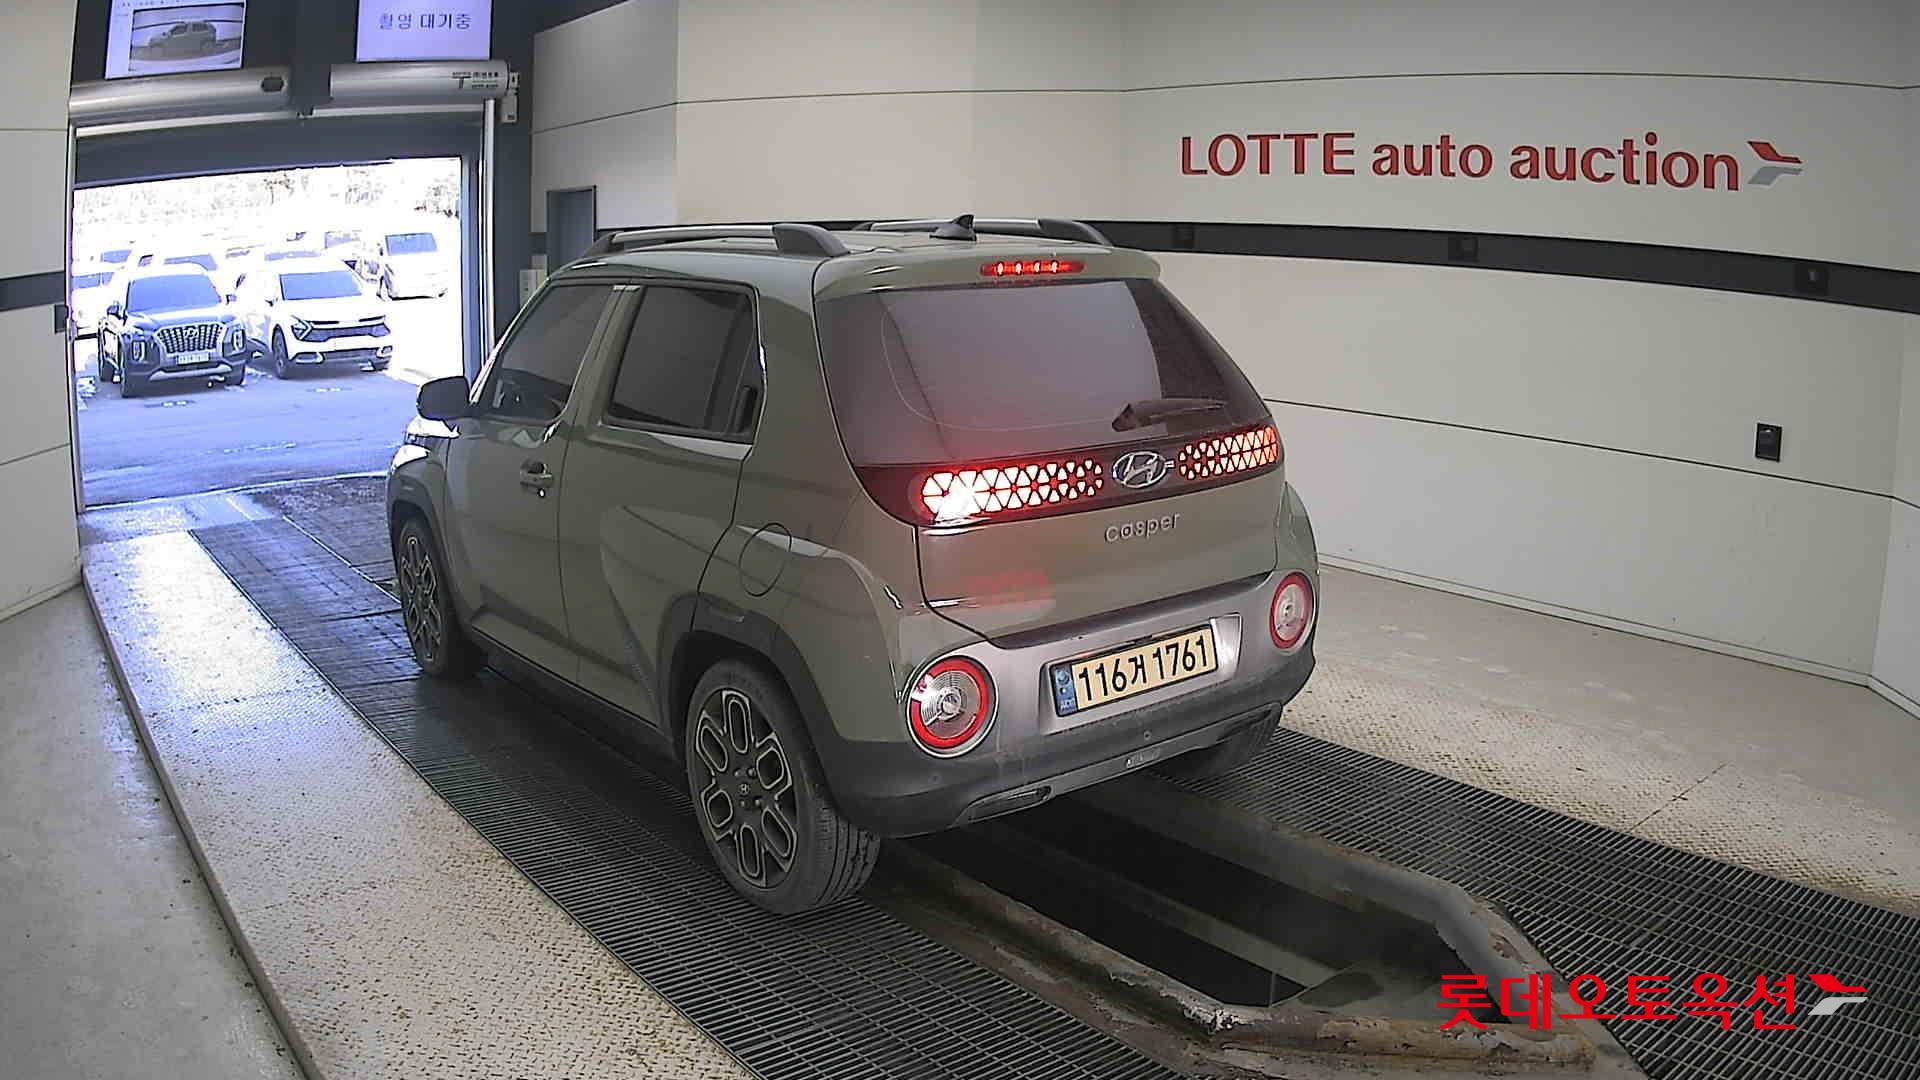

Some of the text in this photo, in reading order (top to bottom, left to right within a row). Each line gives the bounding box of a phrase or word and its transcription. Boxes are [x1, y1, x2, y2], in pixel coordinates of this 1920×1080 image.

[420, 13, 472, 30] 대기중
[1181, 131, 1740, 191] LOTTE auto auction
[1104, 512, 1181, 543] casper
[1078, 634, 1208, 702] 116거 1761
